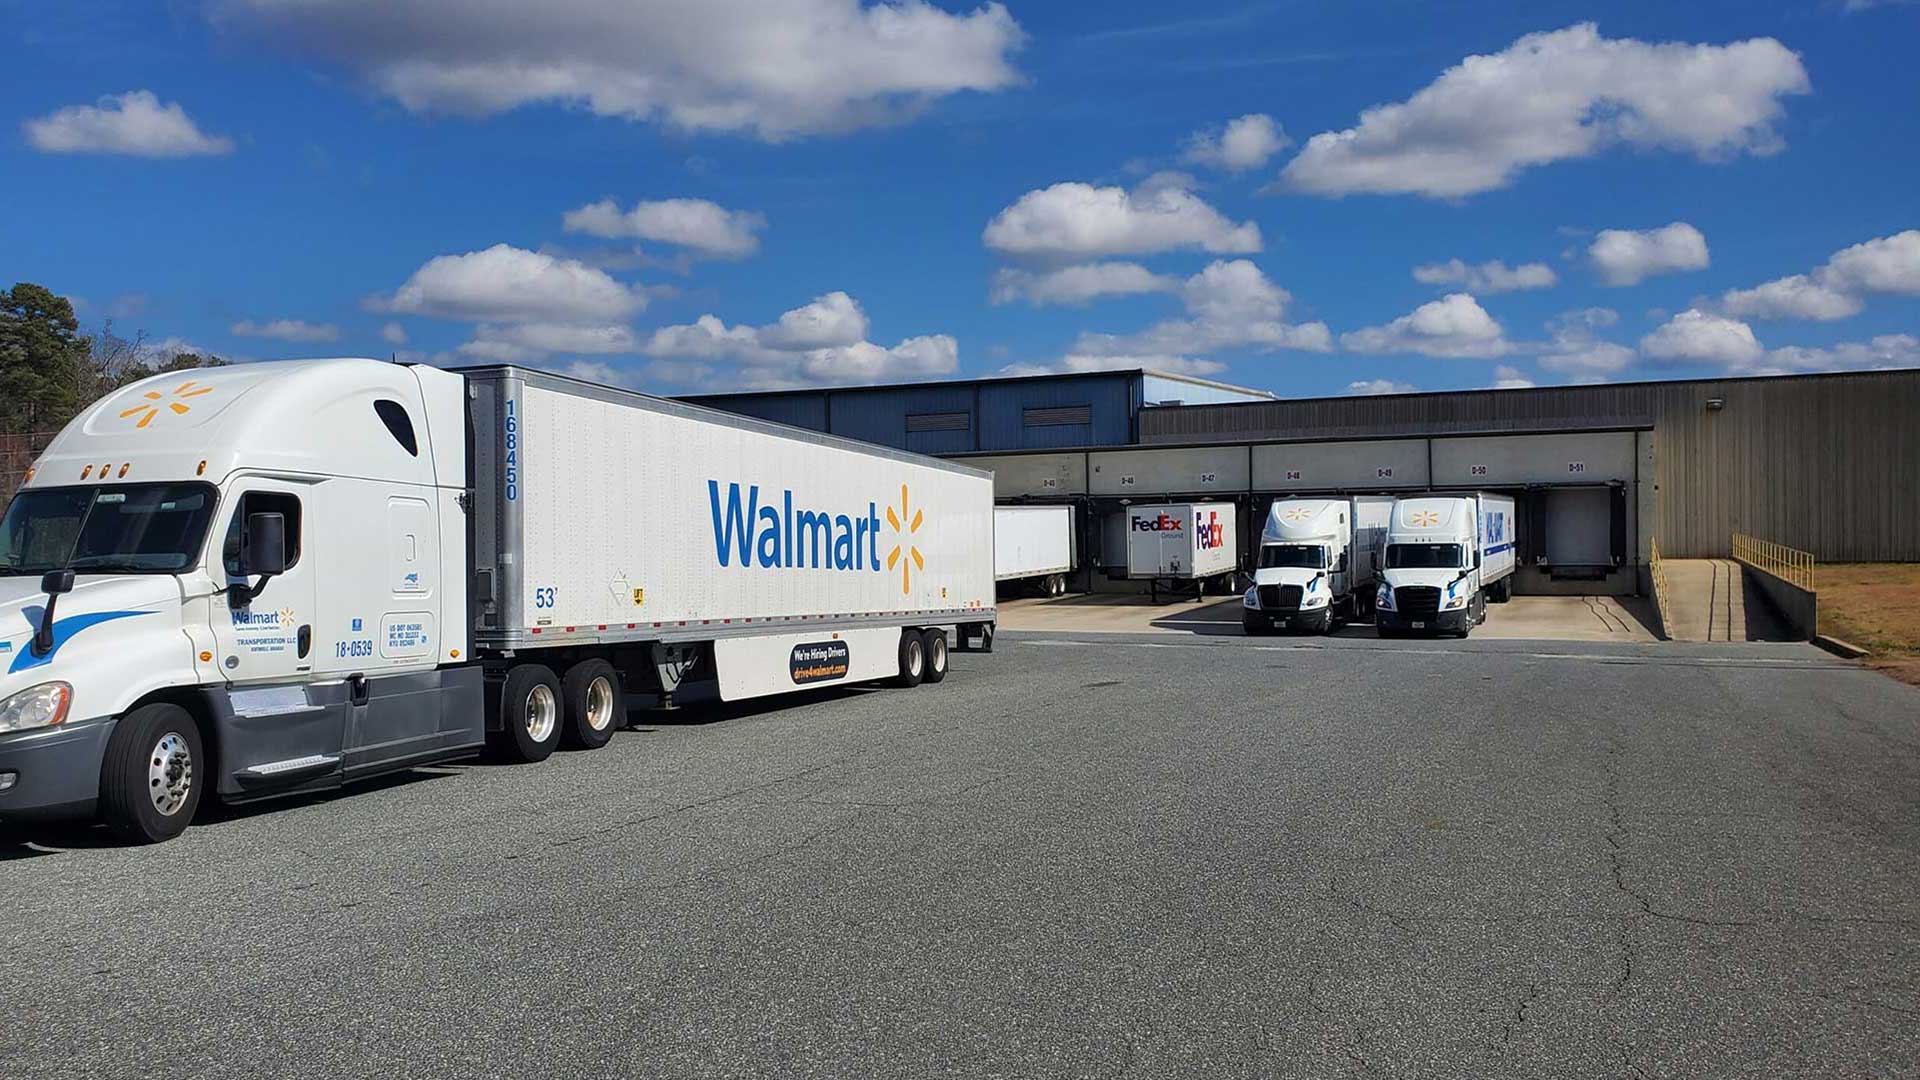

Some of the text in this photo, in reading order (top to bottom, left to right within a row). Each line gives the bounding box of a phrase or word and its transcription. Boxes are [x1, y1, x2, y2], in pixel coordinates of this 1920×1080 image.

[506, 400, 517, 500] 168450
[1569, 463, 1584, 472] D-51
[708, 480, 881, 572] Walmart
[1132, 515, 1183, 531] FedEx
[1196, 511, 1224, 550] FedEx
[536, 587, 558, 608] 53'
[232, 610, 279, 625] Walmart
[237, 636, 297, 646] TRANSPORTATION LLC
[794, 664, 846, 679] drive4walmart.com
